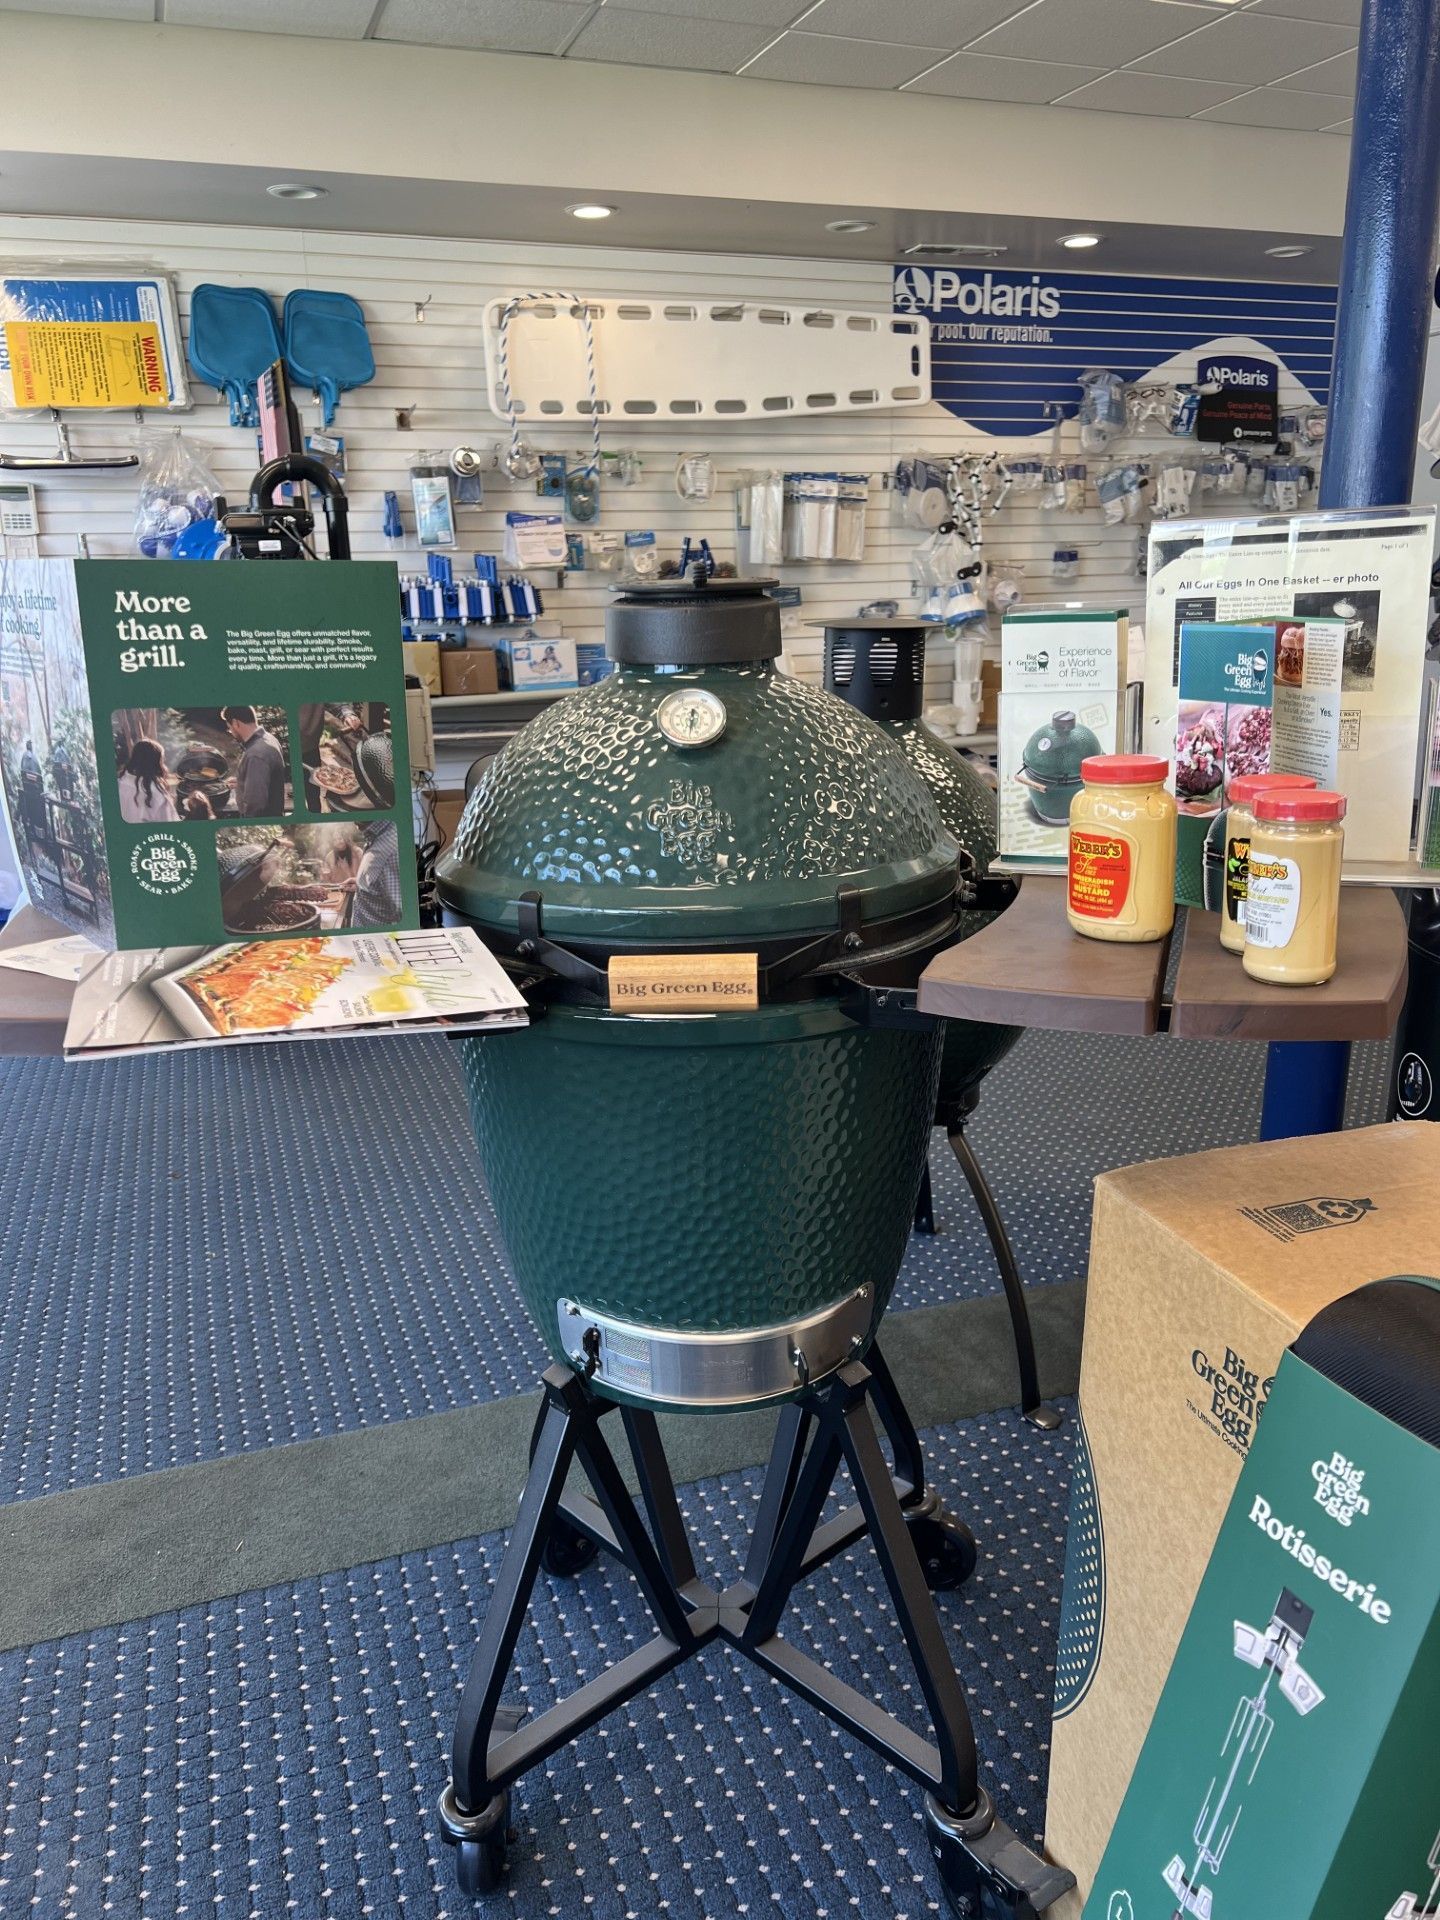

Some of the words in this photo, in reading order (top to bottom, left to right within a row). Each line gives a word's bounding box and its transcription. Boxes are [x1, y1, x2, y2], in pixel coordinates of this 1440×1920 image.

[933, 271, 1060, 318] Polaris
[938, 324, 966, 341] pool.
[969, 323, 988, 339] Our
[991, 325, 1053, 343] reputation.
[141, 336, 161, 393] WARNING
[1220, 368, 1268, 386] Polaris
[26, 386, 35, 400] RISK
[1178, 580, 1192, 590] All
[1195, 580, 1213, 590] Our
[1216, 579, 1242, 591] Eggs
[1245, 578, 1255, 587] In
[1258, 577, 1279, 587] One
[1282, 575, 1319, 586] Basket
[1333, 576, 1344, 584] er
[1347, 573, 1379, 584] photo
[24, 589, 57, 611] lifetime
[114, 590, 191, 613] More
[116, 617, 184, 640] than
[189, 623, 208, 640] a
[241, 630, 253, 639] Big
[254, 630, 275, 638] Green
[276, 630, 290, 639] Egg
[312, 629, 350, 637] unmatched
[120, 644, 186, 672] grill.
[227, 647, 247, 655] bake,
[228, 656, 248, 664] every
[355, 654, 377, 662] legacy
[1026, 653, 1037, 661] Big
[1059, 647, 1112, 657] Experience
[329, 662, 367, 670] community.
[1068, 659, 1095, 667] World
[1224, 663, 1252, 676] Green
[1238, 653, 1253, 668] Big
[1059, 669, 1068, 678] of
[1071, 669, 1098, 678] Flavor
[1234, 675, 1252, 689] Egg
[1320, 707, 1332, 718] Yes.
[670, 778, 712, 808] Big
[646, 798, 736, 832] Green
[148, 833, 175, 842] GRILL
[661, 827, 717, 865] Egg
[150, 847, 177, 861] Big
[1072, 837, 1121, 857] WEBER'S
[130, 844, 142, 873] ROAST
[141, 858, 187, 870] Green
[181, 842, 198, 871] SMOKE
[151, 868, 180, 883] Egg
[139, 880, 162, 895] SEAR
[171, 878, 193, 894] BAKE
[1074, 884, 1110, 897] MUSTARD
[395, 933, 463, 967] LIFE
[617, 983, 647, 997] Big
[651, 982, 707, 995] Green
[1223, 1346, 1259, 1400] Big
[1191, 1349, 1254, 1421] Green
[1186, 1399, 1197, 1415] The
[1197, 1407, 1221, 1437] Ultimate
[1221, 1432, 1248, 1461] Cooking
[1329, 1451, 1365, 1491] Big
[1311, 1460, 1370, 1515] Green
[1313, 1482, 1352, 1527] Egg
[1249, 1494, 1392, 1625] Rotisserie
